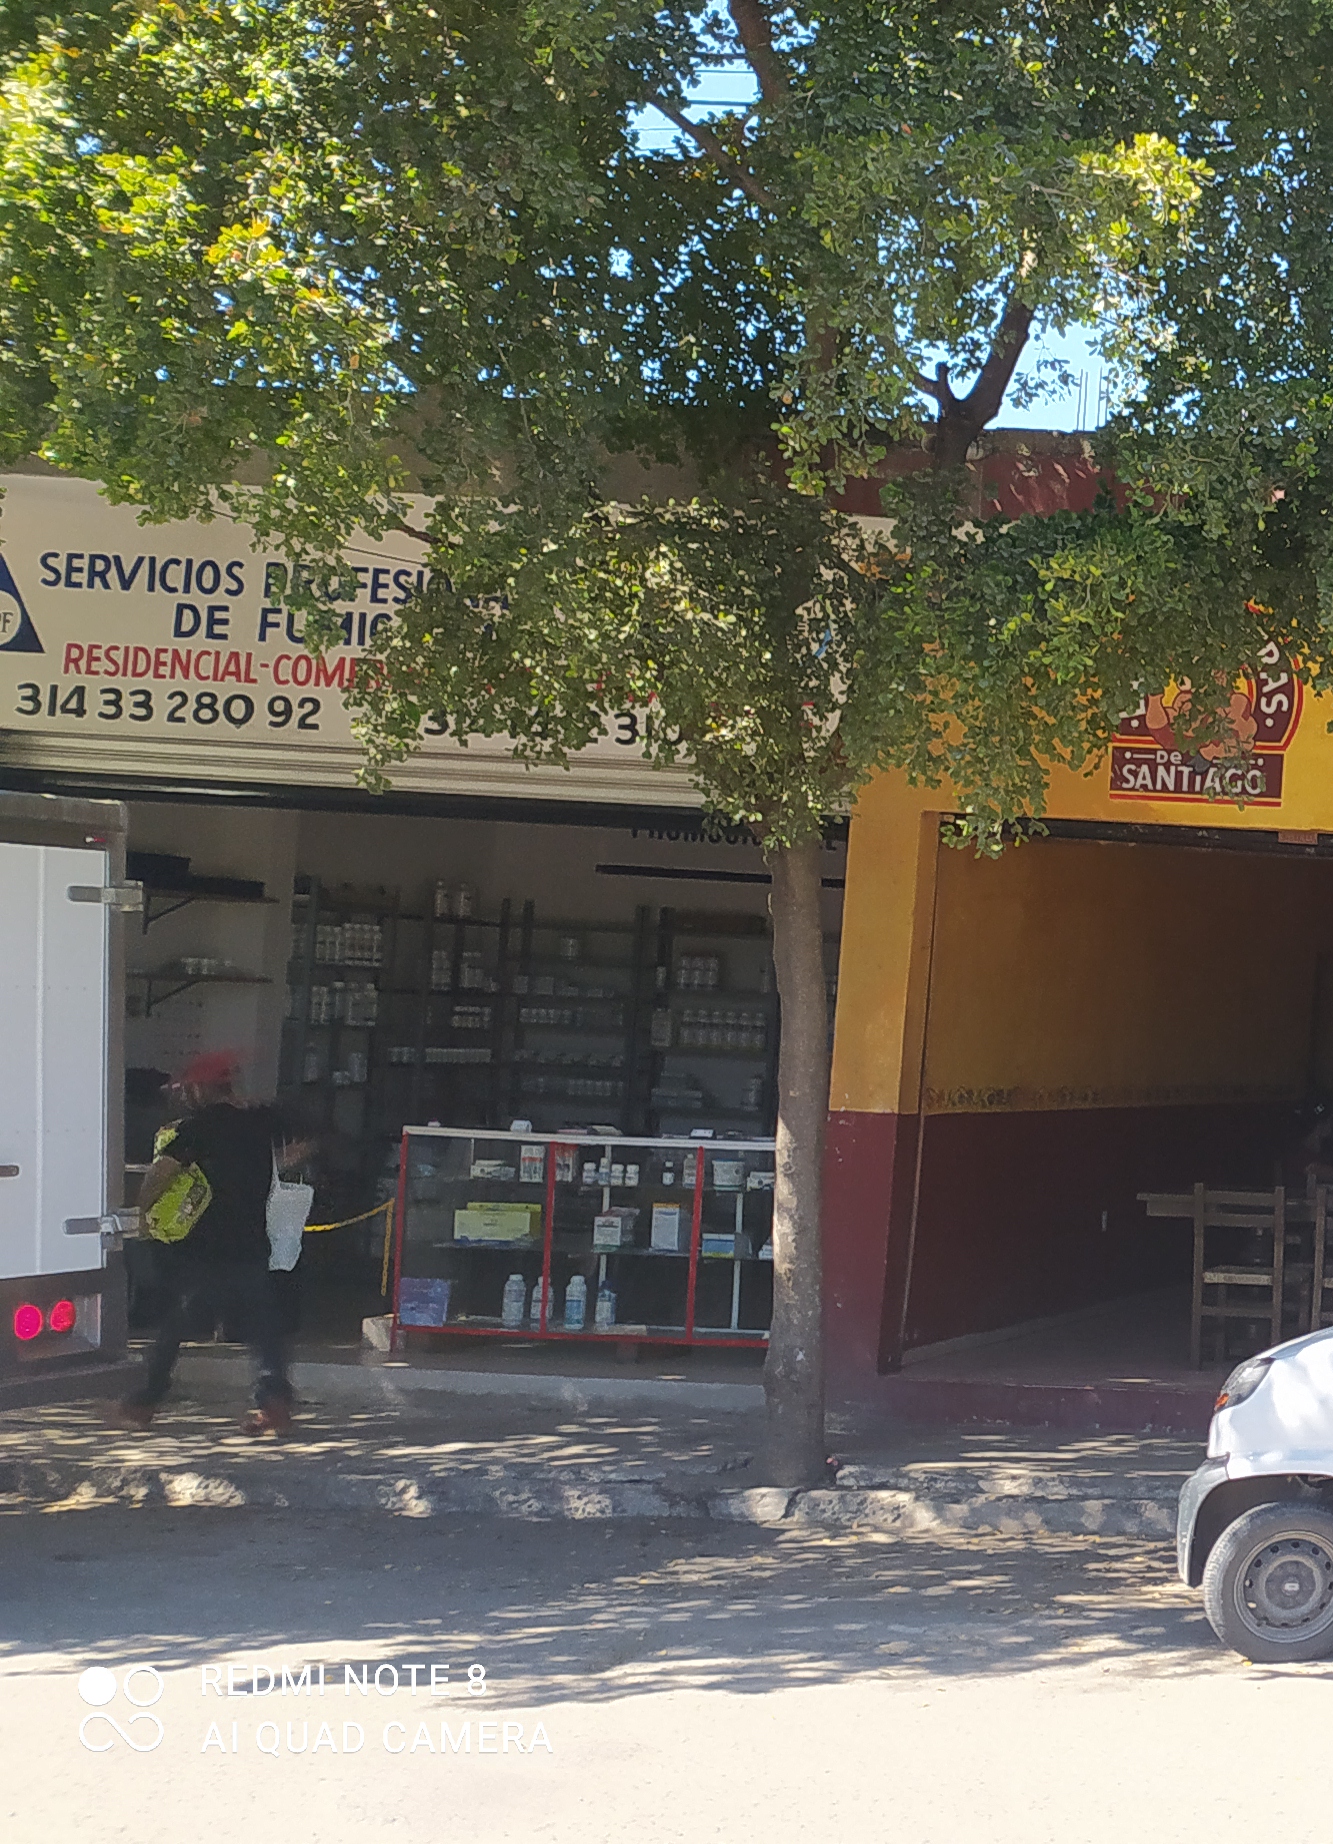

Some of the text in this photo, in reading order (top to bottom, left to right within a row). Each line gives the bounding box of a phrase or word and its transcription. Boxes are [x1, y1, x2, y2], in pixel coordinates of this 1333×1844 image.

[40, 551, 245, 597] SERVICIOS
[173, 603, 230, 640] DE
[14, 682, 321, 731] 314 33 280 92
[1121, 763, 1267, 795] SANTIAGO
